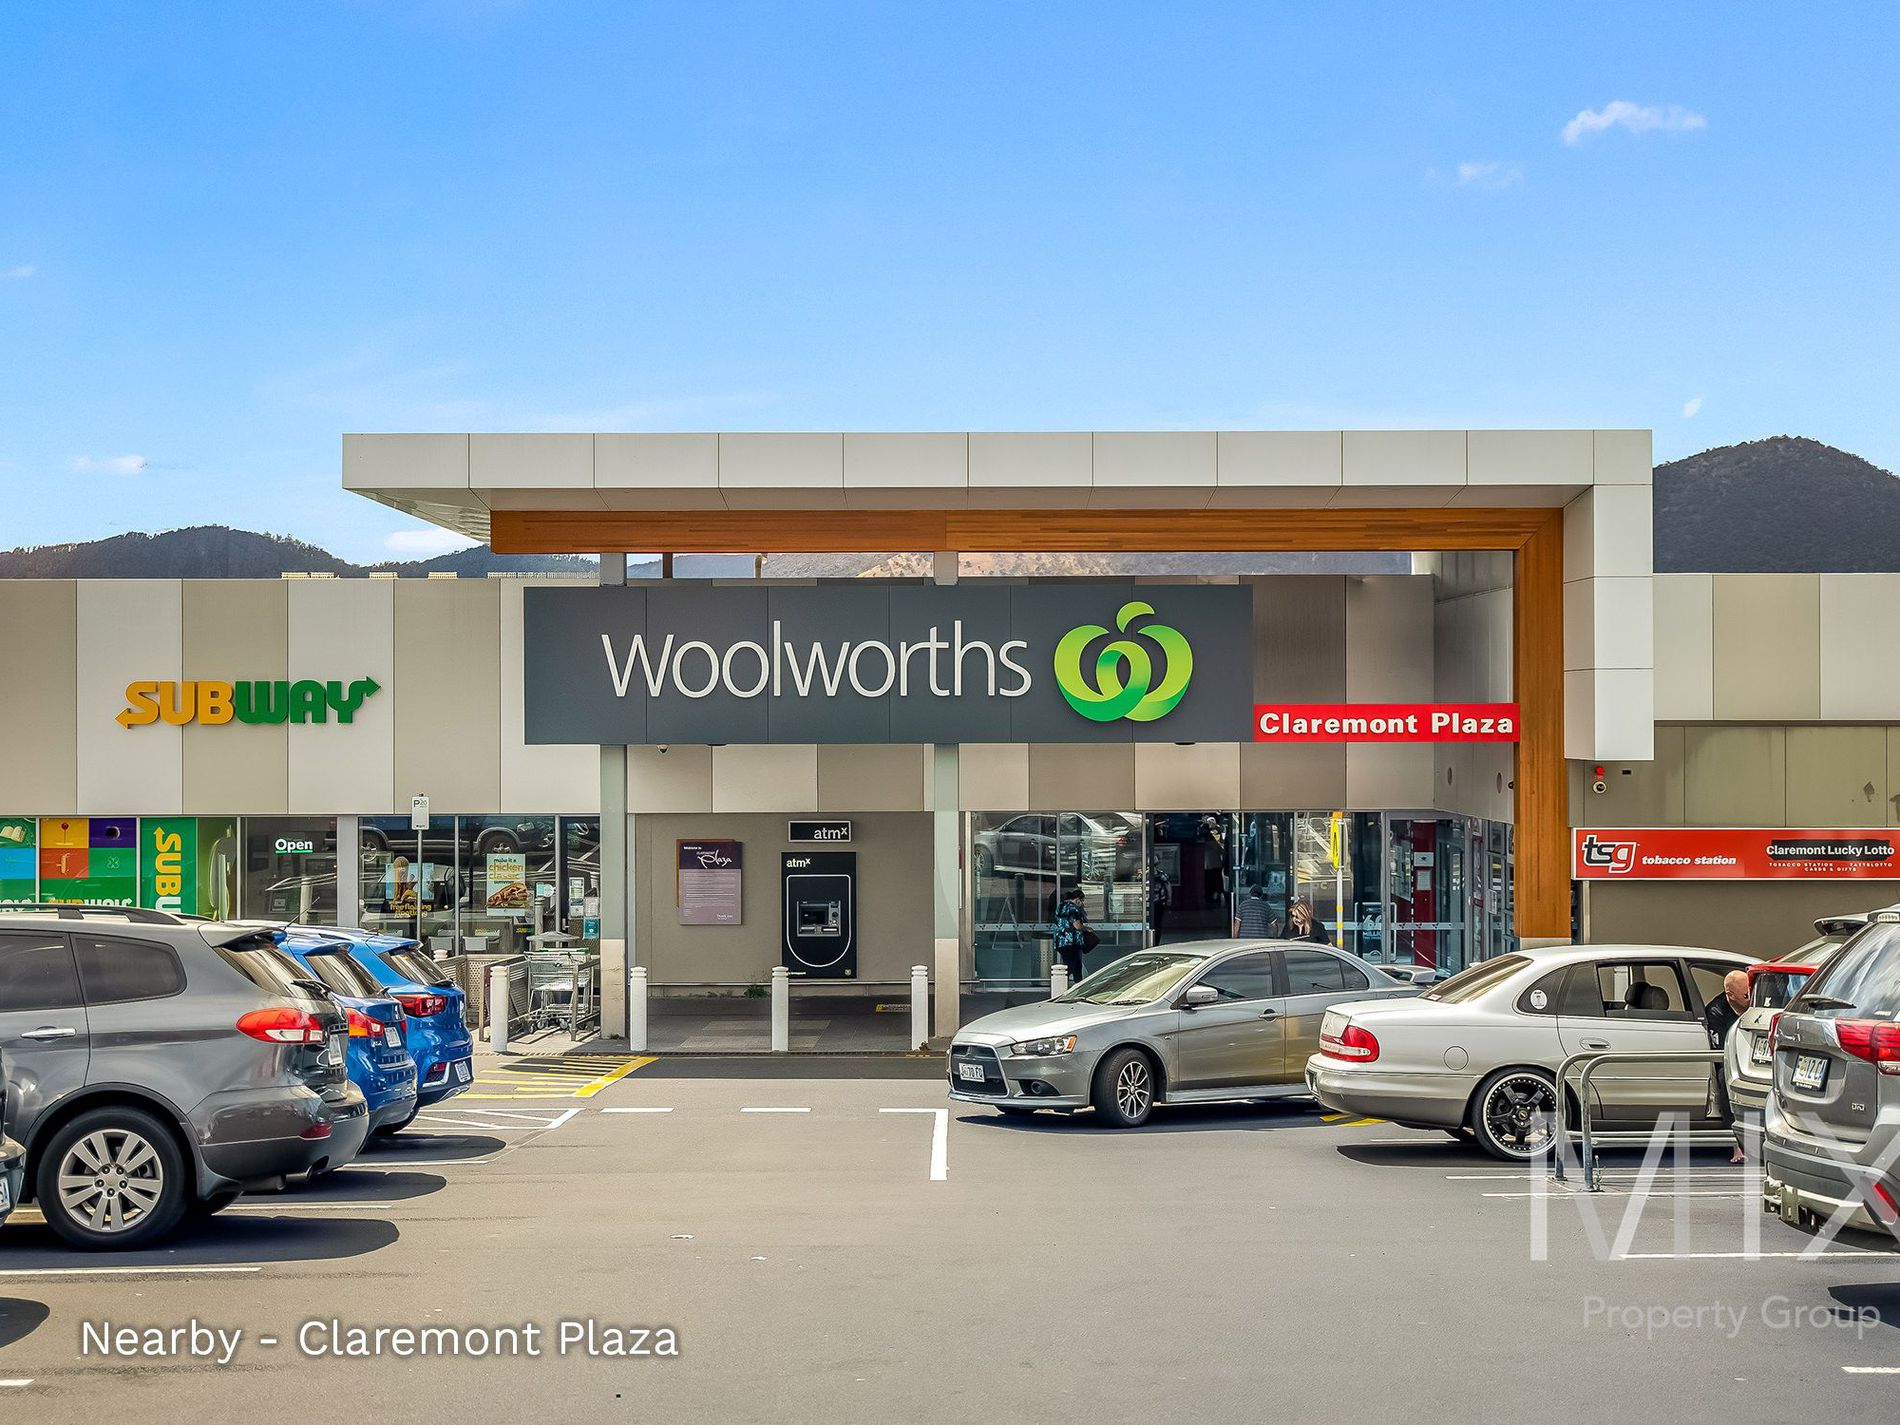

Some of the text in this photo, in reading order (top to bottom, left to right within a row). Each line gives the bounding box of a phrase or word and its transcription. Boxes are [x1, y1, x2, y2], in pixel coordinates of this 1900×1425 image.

[601, 620, 1032, 698] Woolworths
[114, 676, 381, 729] SUBWAY
[1260, 712, 1513, 734] Claremont Plaza
[275, 838, 313, 854] Open
[1582, 834, 1637, 874] tsg
[1766, 845, 1895, 857] Claremont Lucky Lotto
[488, 862, 524, 871] chicken
[1641, 855, 1737, 865] tobacco station
